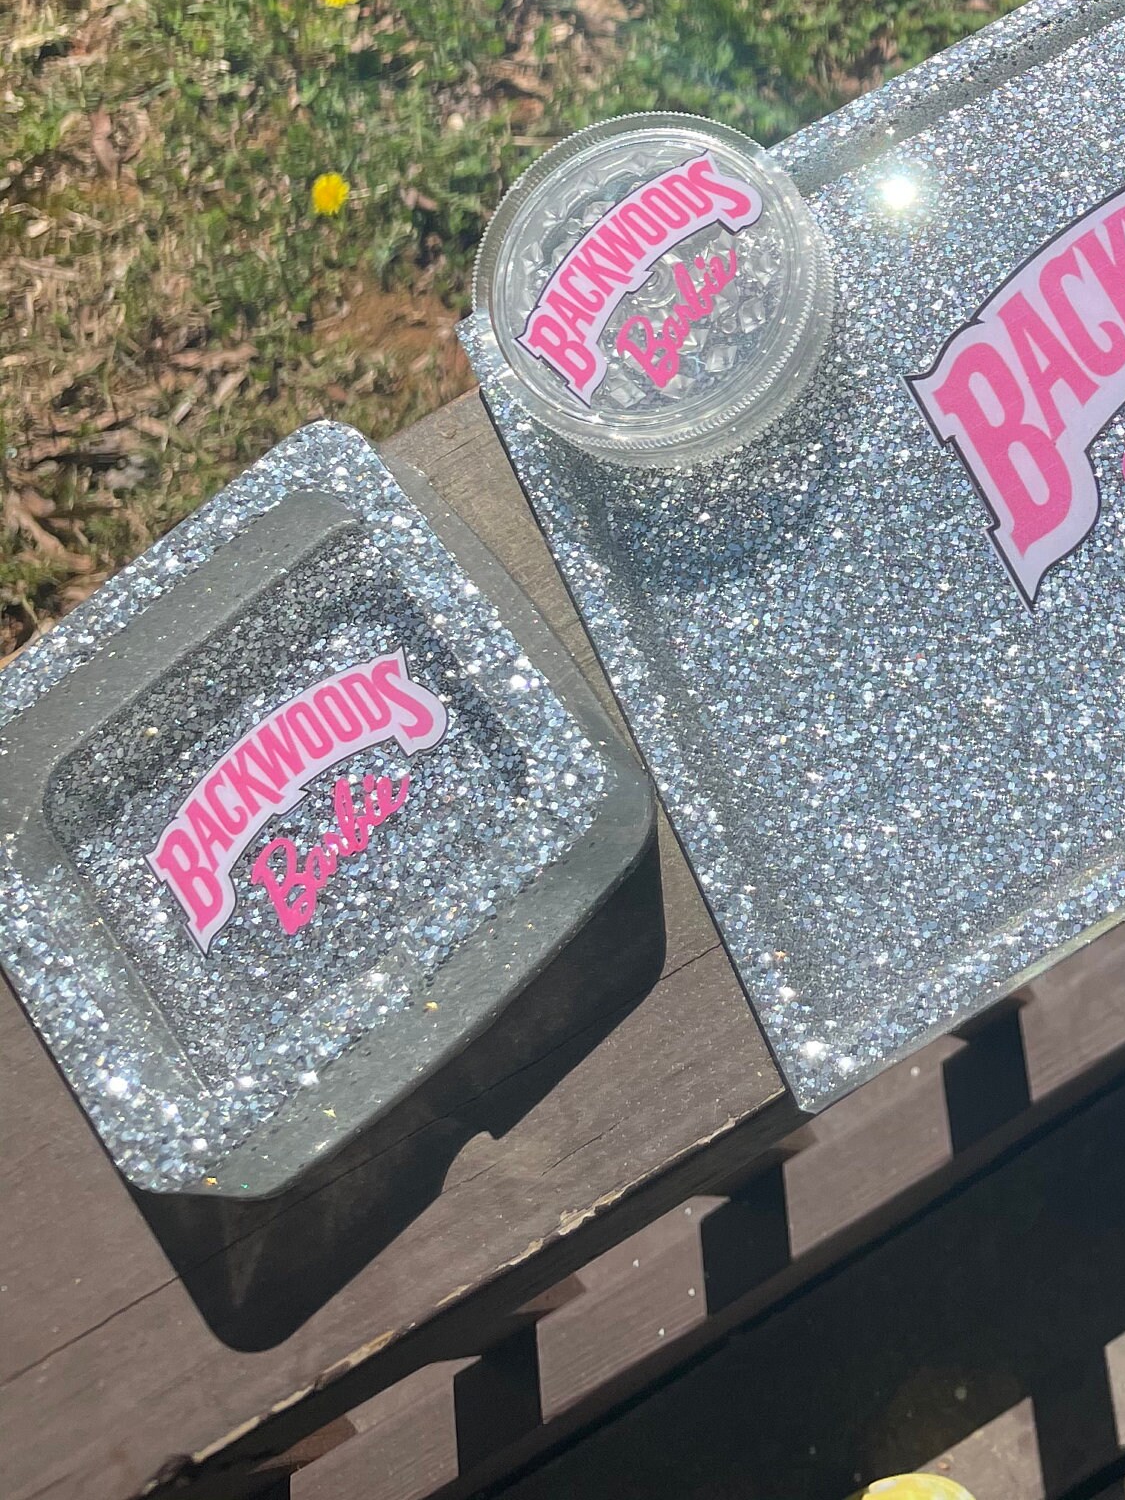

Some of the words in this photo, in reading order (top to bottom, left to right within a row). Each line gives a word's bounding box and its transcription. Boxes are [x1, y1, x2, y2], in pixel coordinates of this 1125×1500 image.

[527, 159, 751, 390] BACKWOODS
[616, 247, 738, 388] Barbie
[156, 659, 434, 932] BACKWOODS
[252, 773, 411, 935] Barbie
